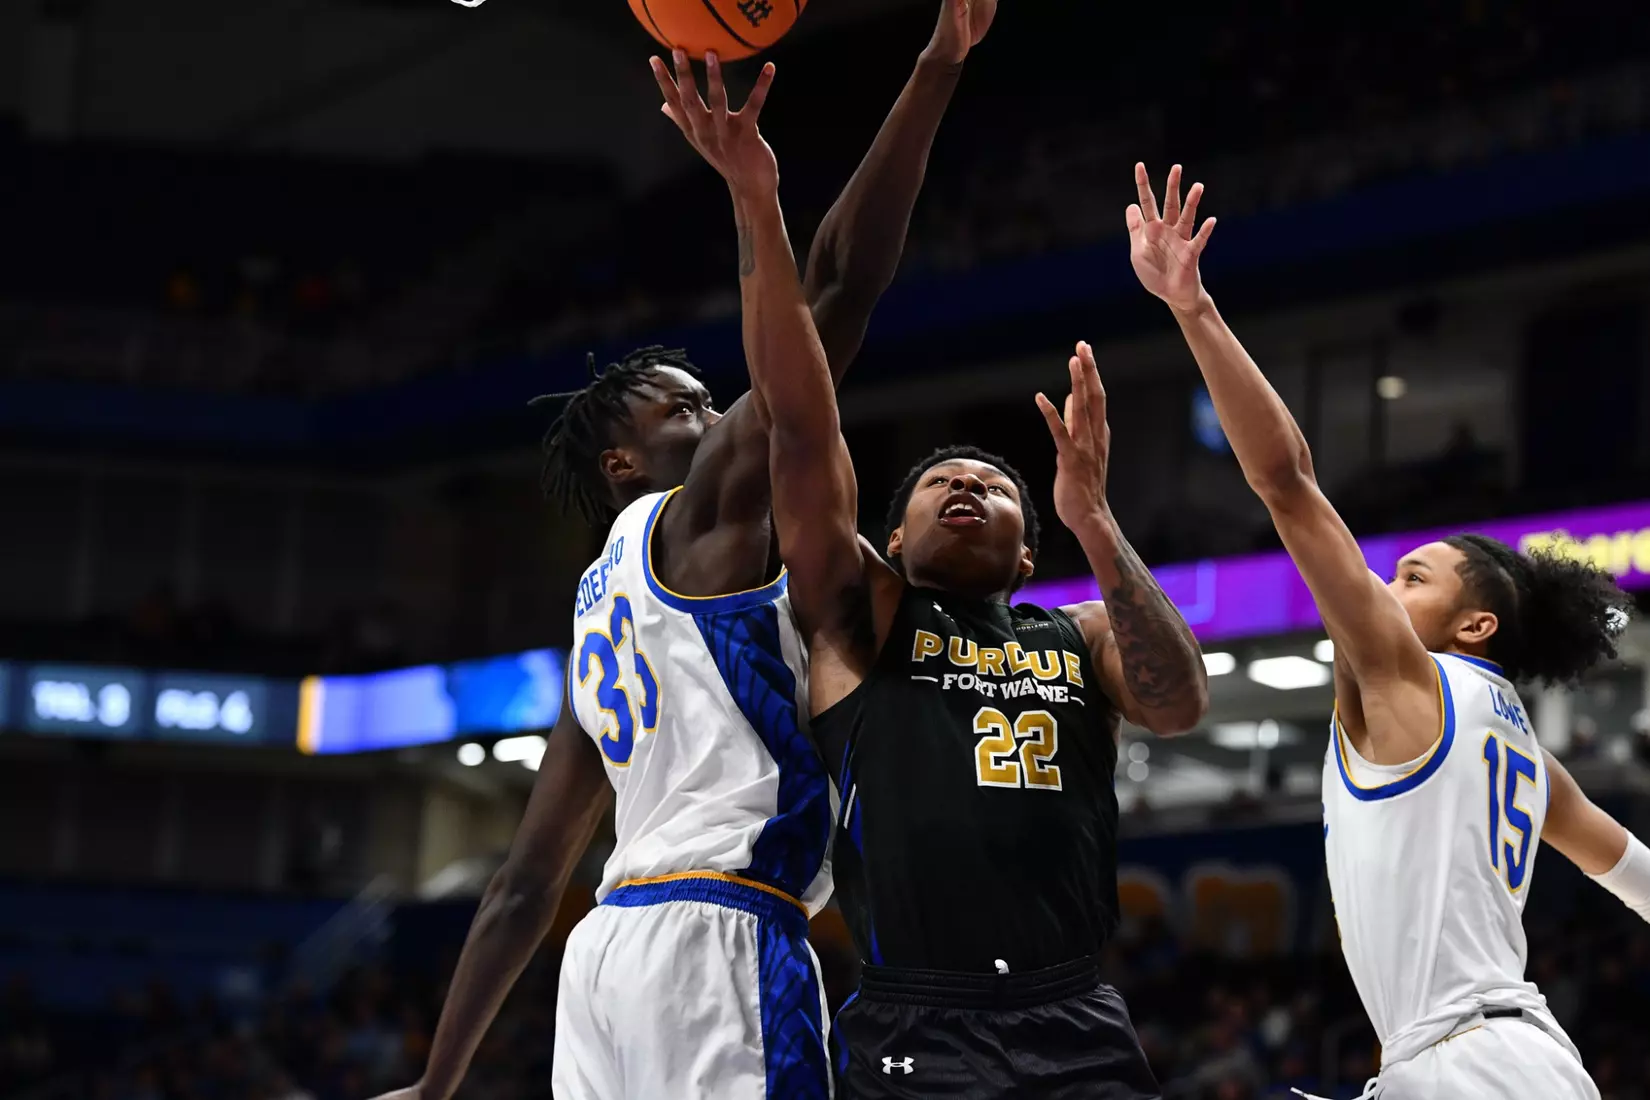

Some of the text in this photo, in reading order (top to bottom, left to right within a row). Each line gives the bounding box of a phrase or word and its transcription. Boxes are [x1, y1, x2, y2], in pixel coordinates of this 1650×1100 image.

[579, 592, 661, 767] 33
[912, 629, 1084, 688] PURDUE
[942, 673, 997, 698] FORT
[1488, 684, 1528, 735] LOWE
[973, 706, 1062, 791] 22
[1482, 731, 1537, 894] 15
